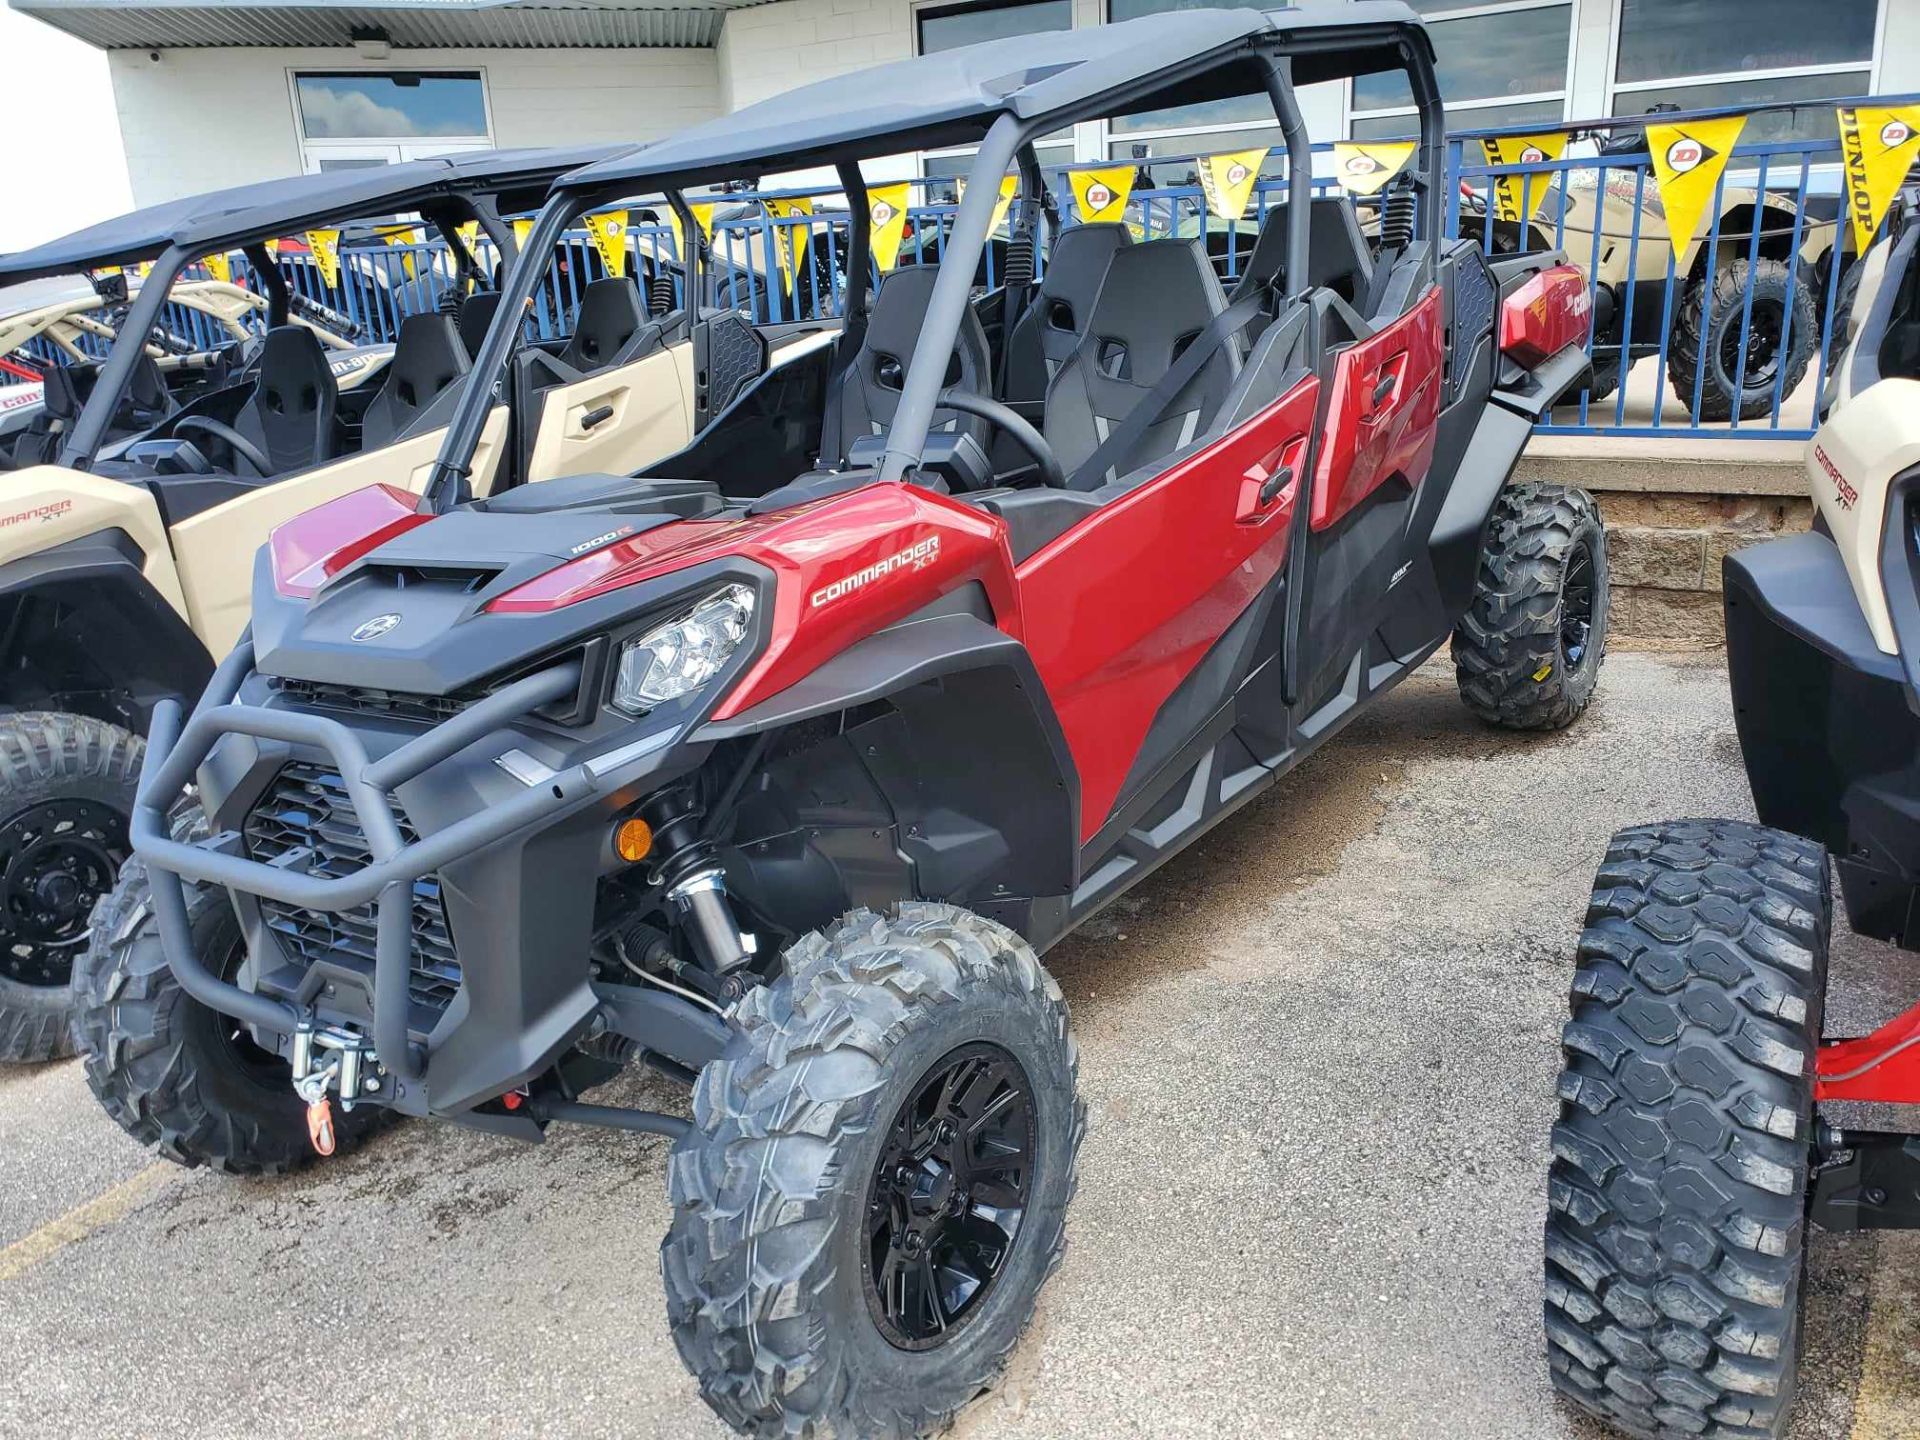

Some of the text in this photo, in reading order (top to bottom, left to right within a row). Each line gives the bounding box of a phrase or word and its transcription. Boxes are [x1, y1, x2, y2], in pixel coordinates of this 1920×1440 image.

[1841, 107, 1874, 232] DUNLOP
[1814, 444, 1858, 506] COMMANDER
[0, 499, 72, 528] MANDER
[570, 525, 635, 554] 1000R
[811, 535, 939, 608] COMMANDER
